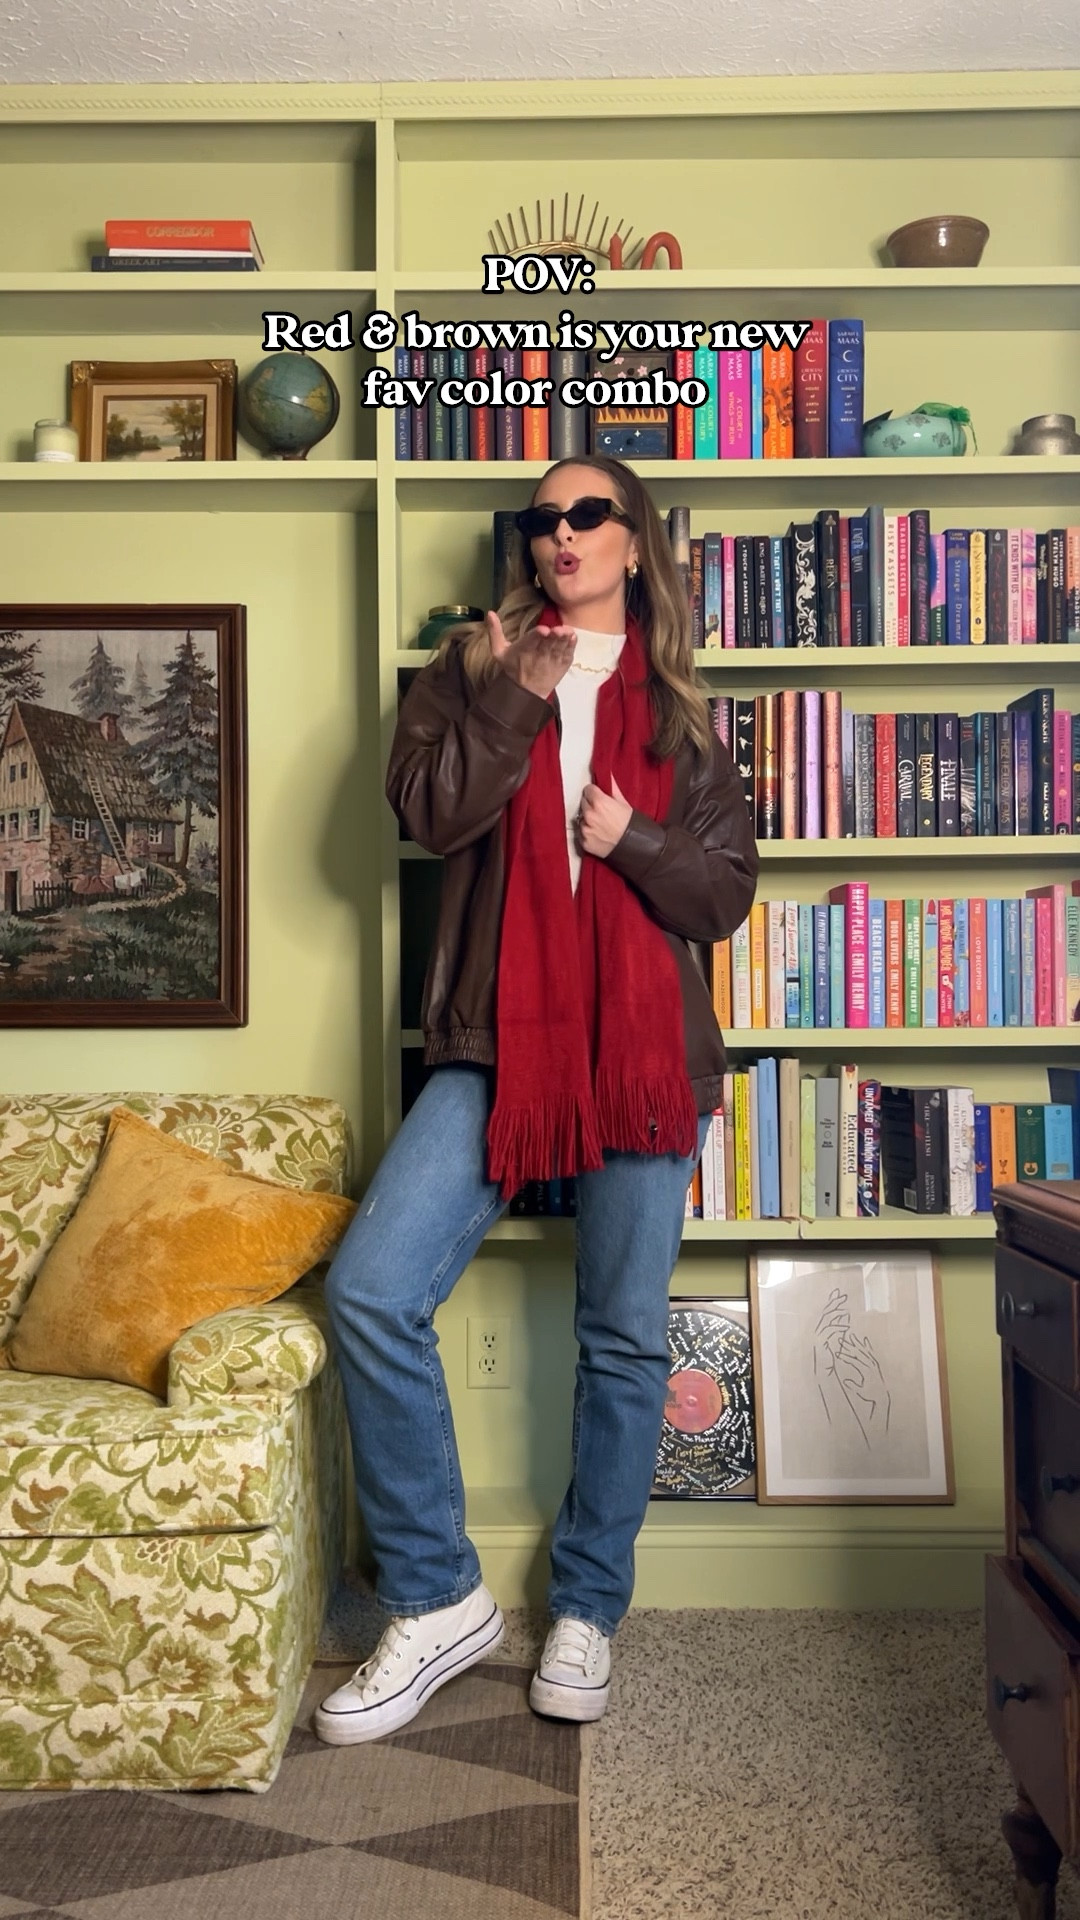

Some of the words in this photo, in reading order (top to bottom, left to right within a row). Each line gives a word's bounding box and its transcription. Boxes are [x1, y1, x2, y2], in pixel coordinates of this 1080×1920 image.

[801, 374, 822, 382] CITY
[837, 374, 858, 382] CITY
[1011, 544, 1019, 562] ENDS
[826, 558, 835, 588] REIGN
[953, 559, 961, 592] Strange
[1012, 584, 1019, 594] US
[898, 759, 914, 801] CARAVAL
[918, 754, 935, 802] LEGENDARY
[940, 759, 957, 801] FINALE
[852, 888, 865, 916] HAPPY
[941, 905, 951, 917] MR.
[1067, 905, 1078, 921] ELLE
[788, 928, 797, 956] Summer
[852, 919, 865, 945] PLACE
[872, 918, 882, 947] BEACH
[891, 920, 899, 939] BOOK
[940, 919, 951, 942] WRONG
[1068, 924, 1078, 956] KENNEDY
[872, 950, 882, 972] READ
[891, 940, 899, 965] LOVERS
[941, 944, 952, 971] NUMBER
[852, 953, 865, 979] EMILY
[891, 969, 899, 990] EMILY
[852, 982, 865, 1010] HENRY
[891, 992, 899, 1015] HENRY
[864, 1087, 874, 1122] UNTAMED
[715, 1118, 723, 1137] MAKE
[715, 1139, 723, 1149] UP
[847, 1114, 857, 1174] Educated
[864, 1128, 874, 1162] GLENNON
[864, 1164, 874, 1188] DOYLE
